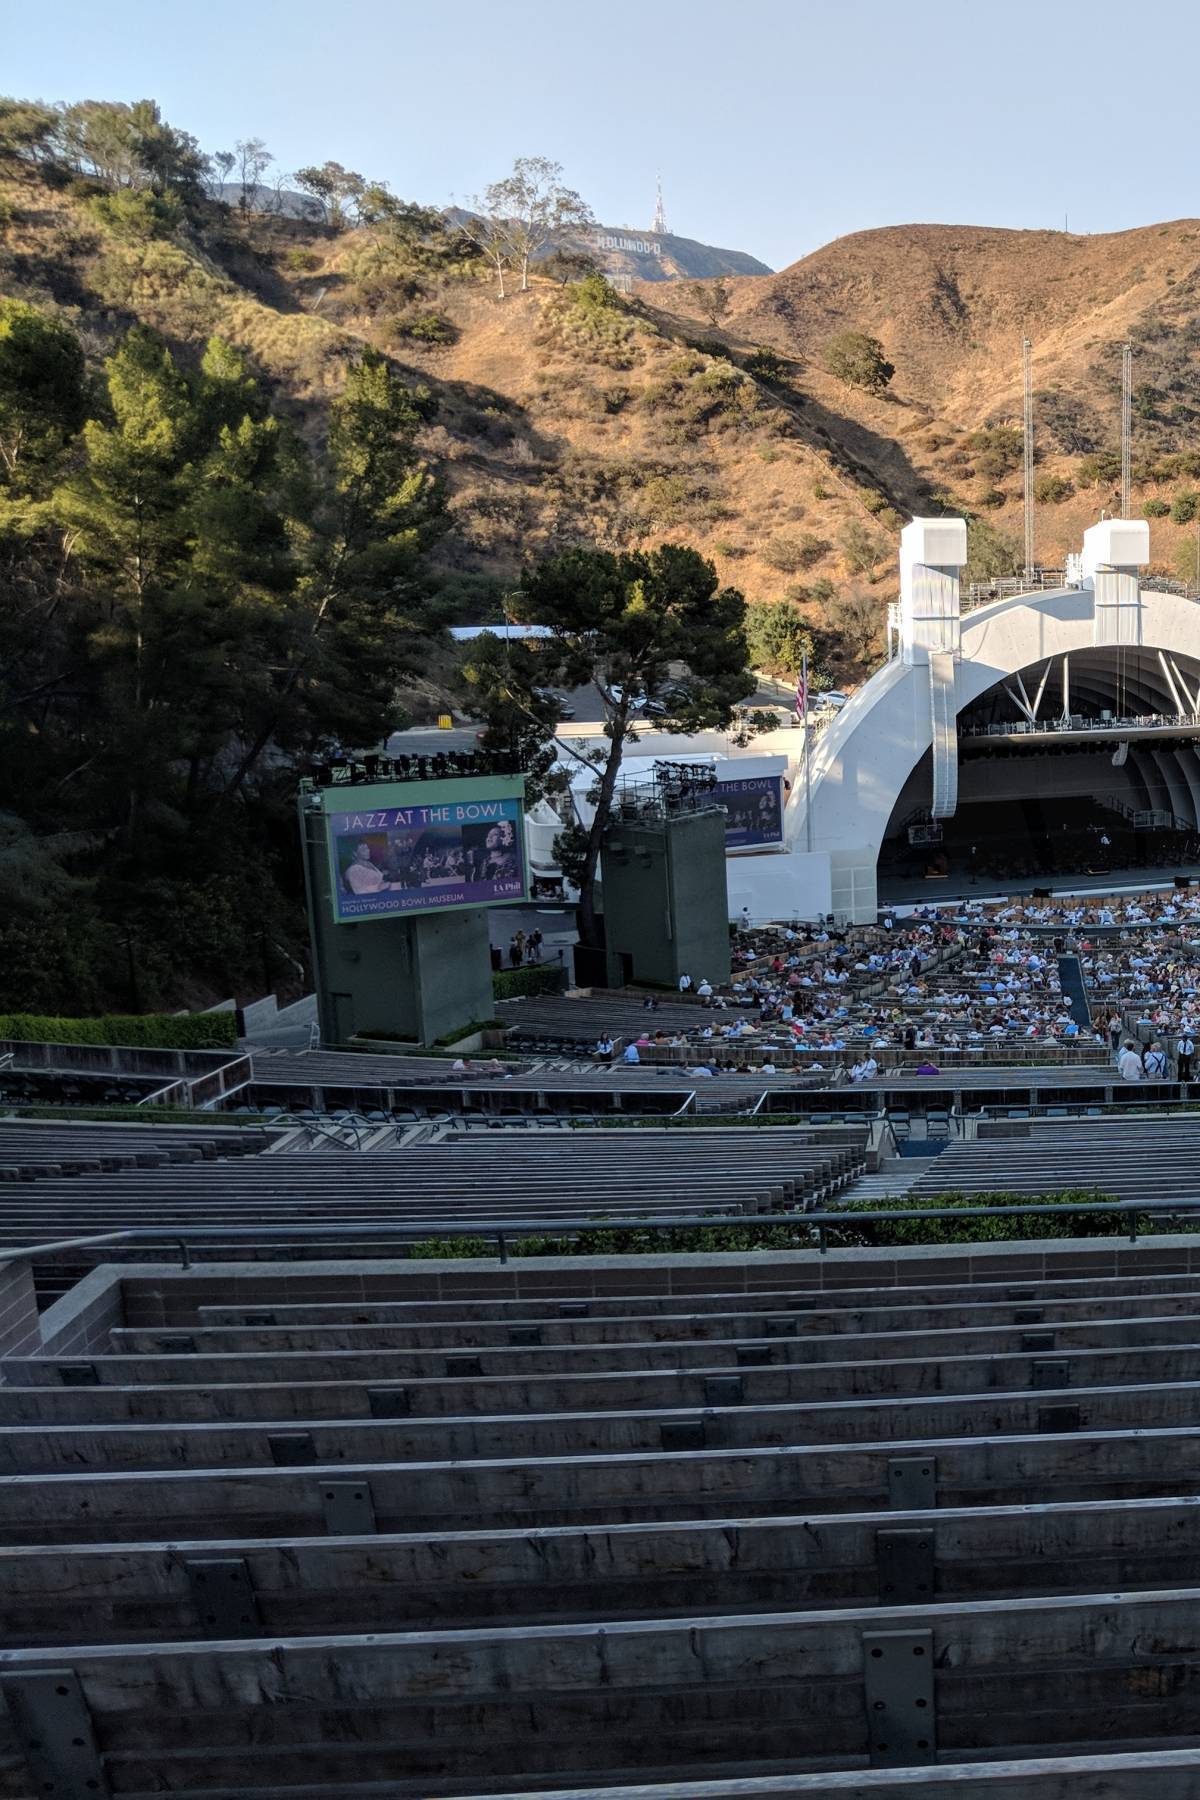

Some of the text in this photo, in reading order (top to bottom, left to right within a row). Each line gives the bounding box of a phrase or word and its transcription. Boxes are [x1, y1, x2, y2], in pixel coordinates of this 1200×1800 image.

[596, 235, 661, 254] HOLLYWOOD
[720, 783, 739, 793] THE
[742, 779, 772, 792] BOWL
[344, 803, 506, 832] JAZZ AT THE BOWL
[505, 881, 521, 891] Phil
[342, 901, 399, 914] HOLLYWOOD
[401, 896, 427, 907] BOWL
[428, 893, 465, 905] MUSEUM
